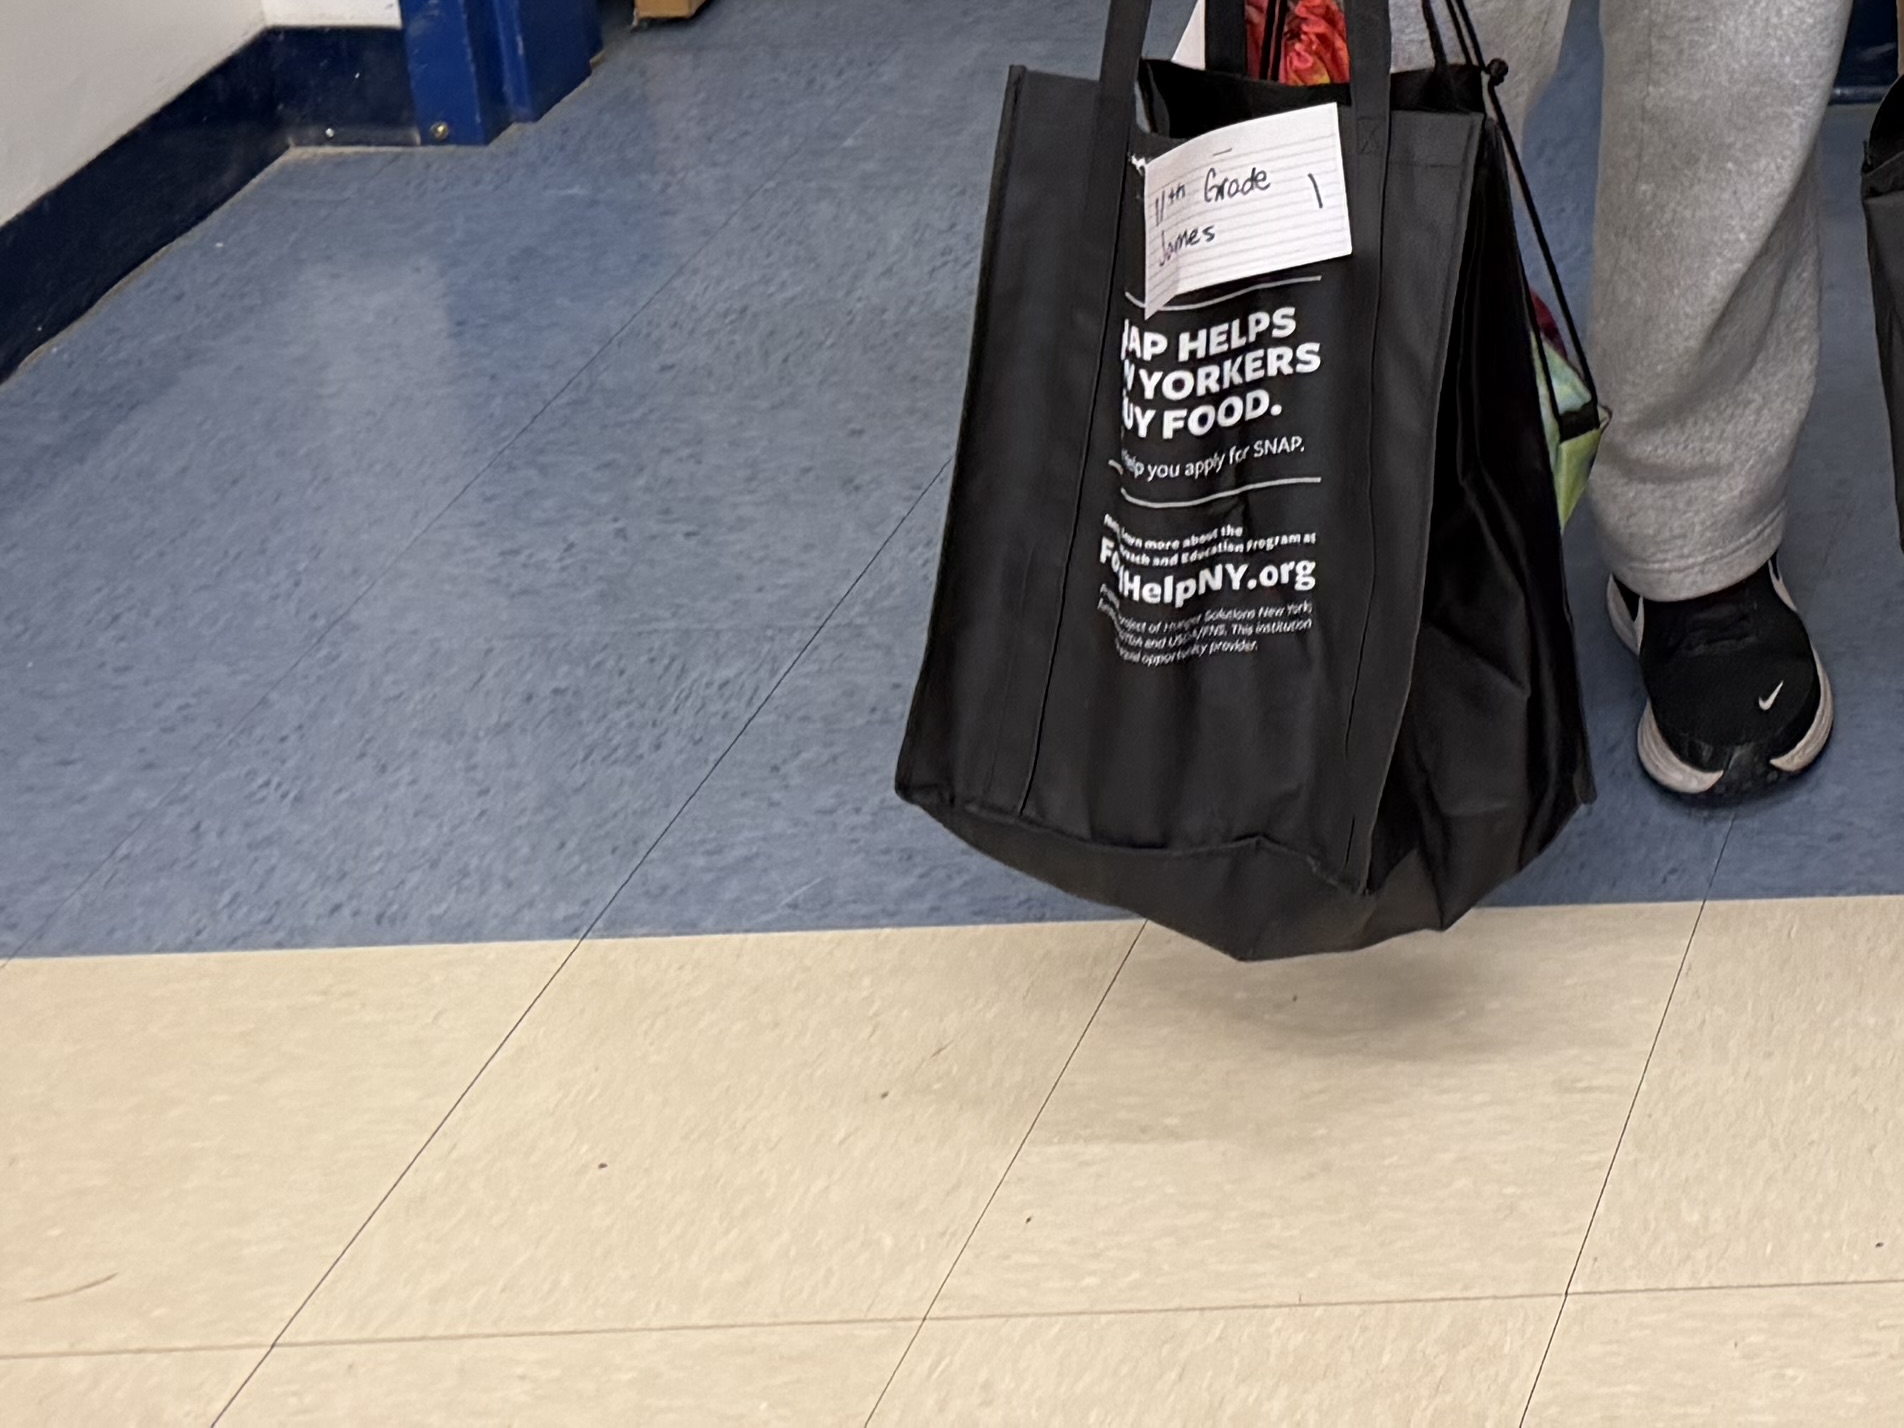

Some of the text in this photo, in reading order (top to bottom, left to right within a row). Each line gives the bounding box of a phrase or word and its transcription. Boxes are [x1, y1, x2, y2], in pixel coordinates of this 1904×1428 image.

[1203, 167, 1272, 204] Grade
[1307, 172, 1324, 209] 1
[1157, 223, 1216, 268] James
[1177, 305, 1297, 363] HELPS
[1138, 341, 1323, 402] YORKERS
[1162, 388, 1284, 441] FOOD.
[1148, 436, 1306, 483] you apply for SNAP.
[1144, 523, 1244, 552] more about the
[1152, 551, 1178, 567] and
[1181, 538, 1245, 564] Education
[1246, 534, 1301, 553] Program
[1303, 532, 1317, 545] at
[1208, 639, 1259, 654] provider.
[1230, 623, 1254, 636] This
[1255, 618, 1313, 635] institution
